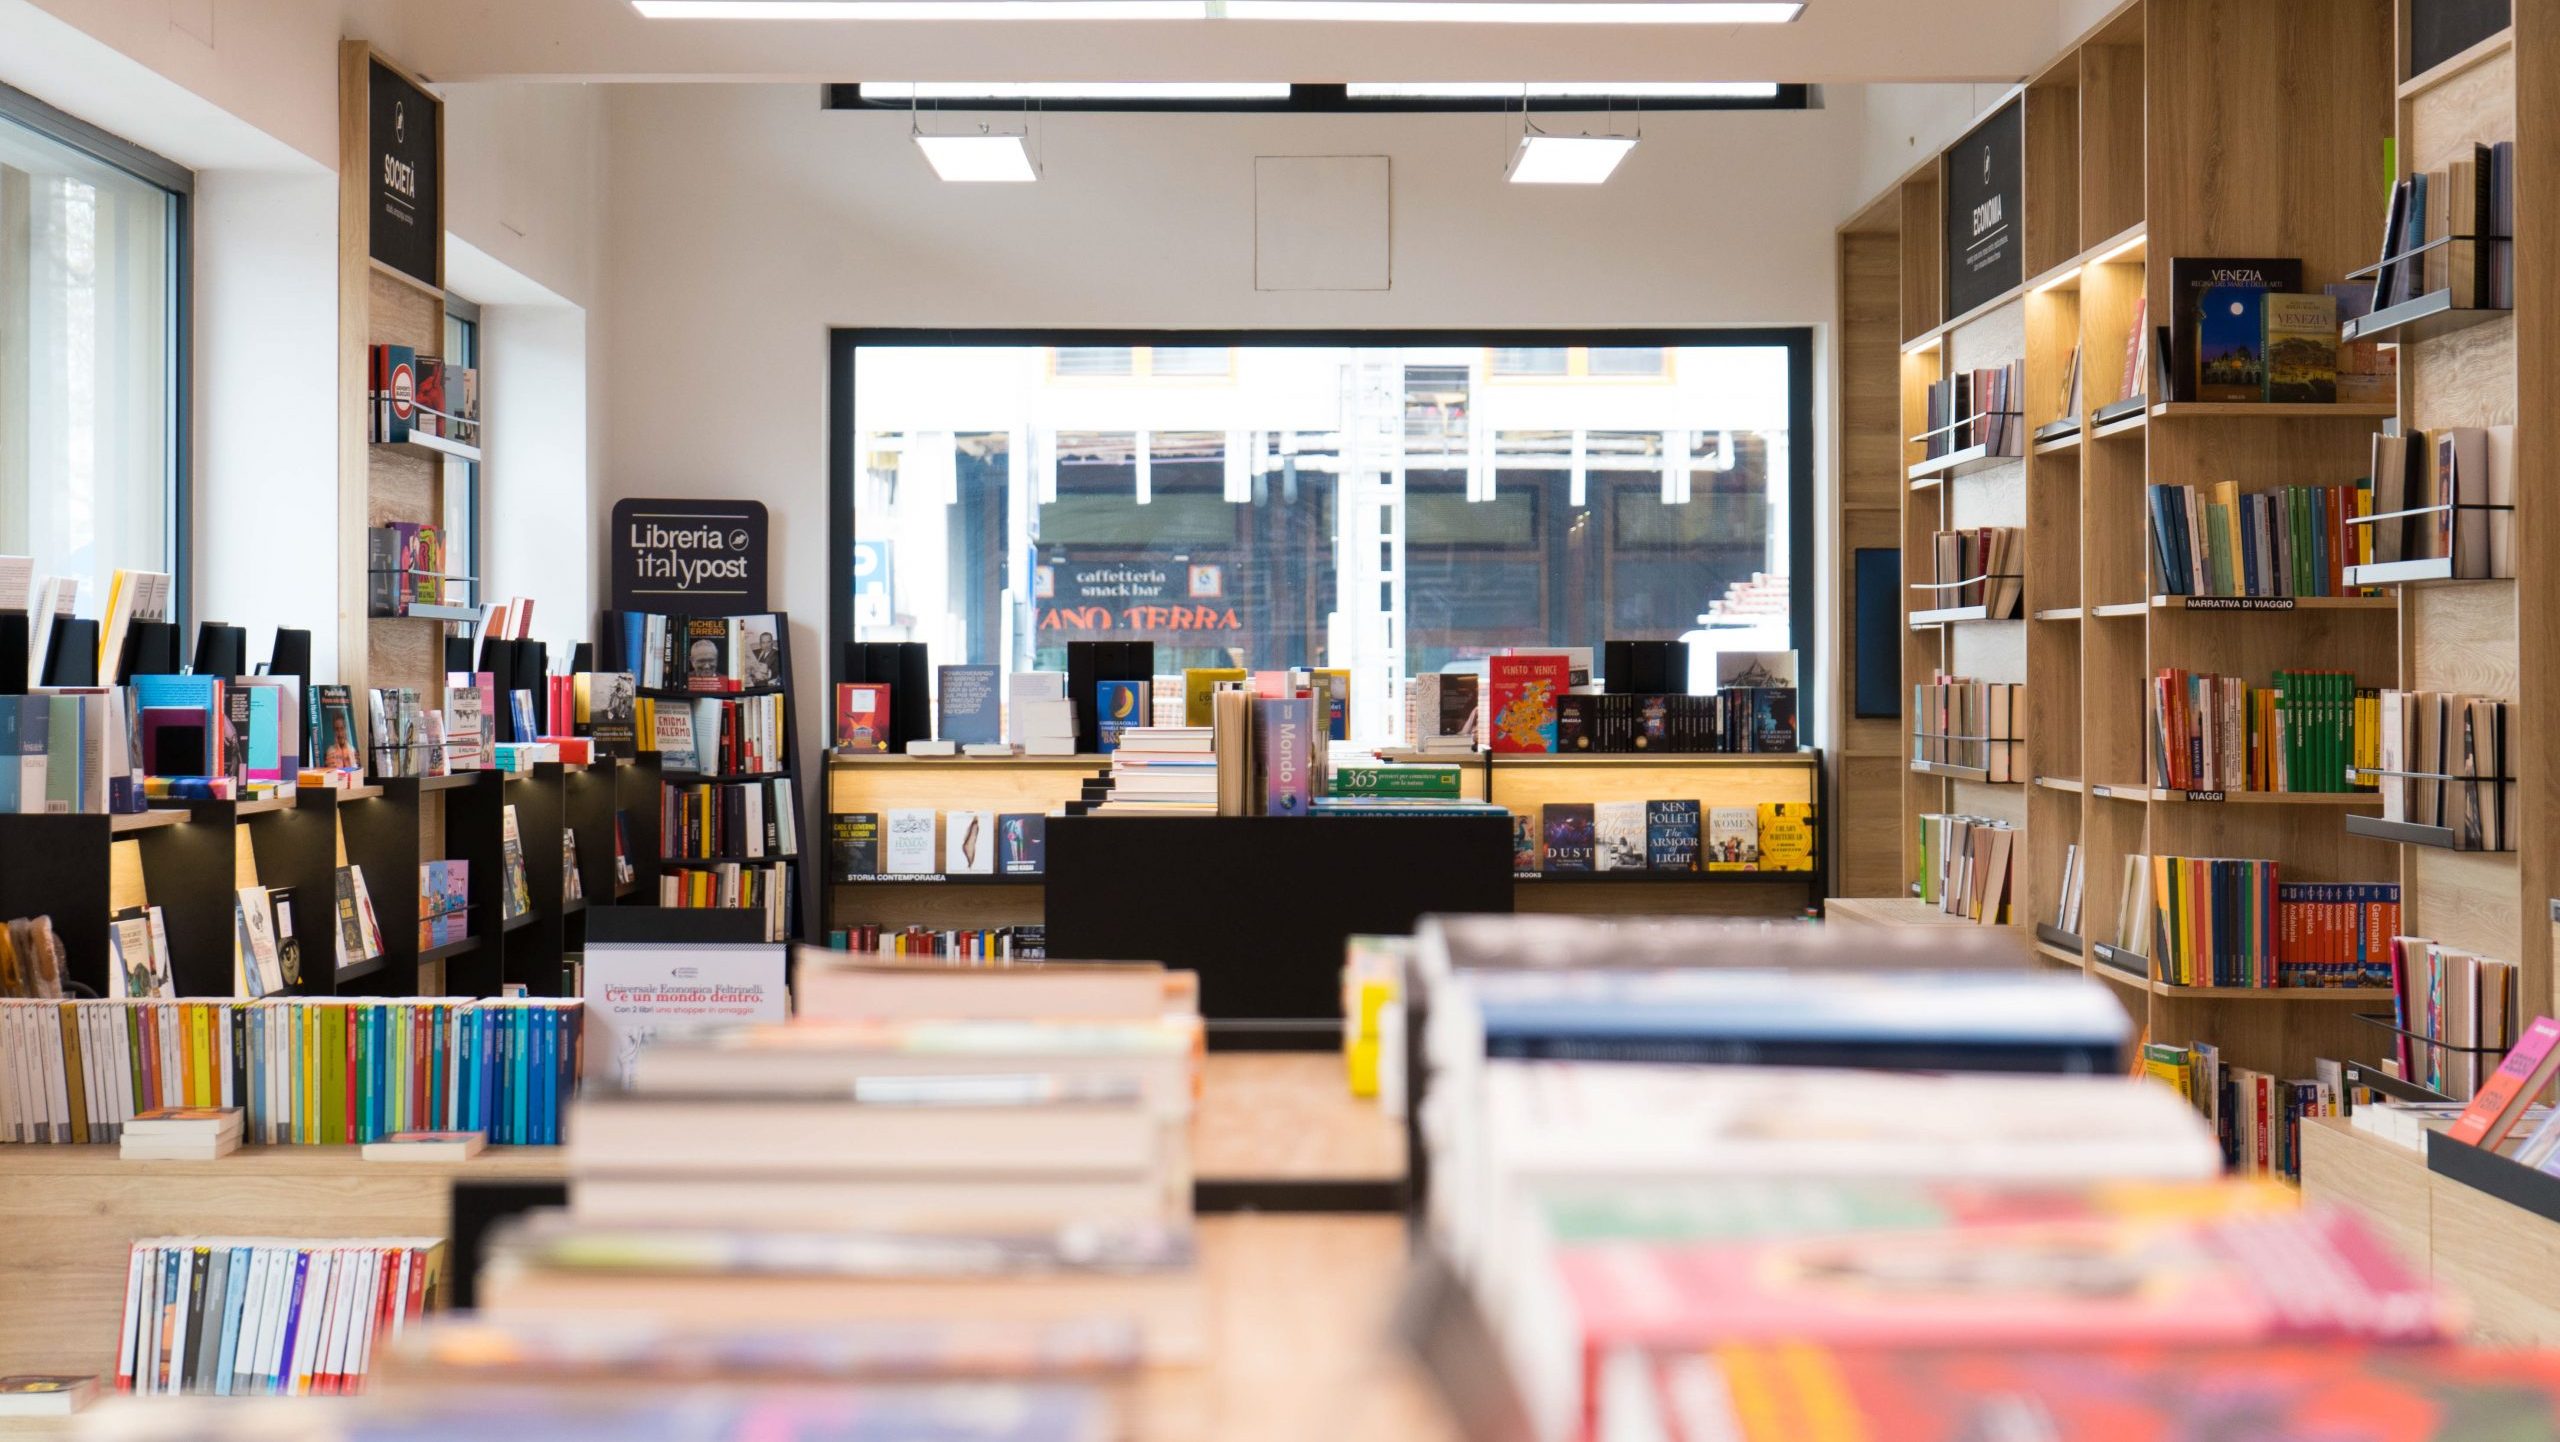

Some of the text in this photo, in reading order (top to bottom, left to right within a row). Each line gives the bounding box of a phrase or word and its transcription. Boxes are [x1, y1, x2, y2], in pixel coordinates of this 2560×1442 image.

[384, 154, 415, 198] SOCIETÀ
[1973, 193, 2002, 236] ECONOMIA
[2211, 269, 2262, 281] VENEZIA
[2277, 313, 2328, 325] VENEZIA
[631, 523, 723, 549] Libreria
[636, 549, 747, 589] italypost
[1076, 569, 1166, 583] caffetteria
[1081, 583, 1162, 597] snack bar
[2187, 600, 2293, 609] NARRATIVA DI VIAGGIO
[1123, 605, 1239, 630] TERRA
[690, 628, 726, 636] ERRERO
[1502, 665, 1557, 675] VENETO VENICE
[658, 716, 687, 727] ENIGMA
[656, 726, 690, 738] PALERMO
[1280, 723, 1296, 782] Mondo
[1345, 770, 1378, 788] 365
[2188, 792, 2223, 801] VIAGGI
[1661, 802, 1685, 811] KEN
[1649, 811, 1698, 824] FOLLETT
[1713, 819, 1754, 828] WOMEN
[1664, 828, 1682, 837] The
[1650, 838, 1699, 847] ARMOUR
[1547, 847, 1593, 858] DUST
[1669, 845, 1678, 855] of
[1655, 854, 1693, 863] LIGHT
[2307, 904, 2315, 935] Corsica
[2371, 903, 2381, 953] Germania
[604, 984, 657, 994] Universale
[660, 983, 712, 994] Economica
[632, 992, 651, 1002] un
[656, 991, 706, 1002] mondo
[711, 991, 763, 1003] dentro.
[673, 1006, 707, 1015] shopper
[717, 1007, 755, 1016] omaggio
